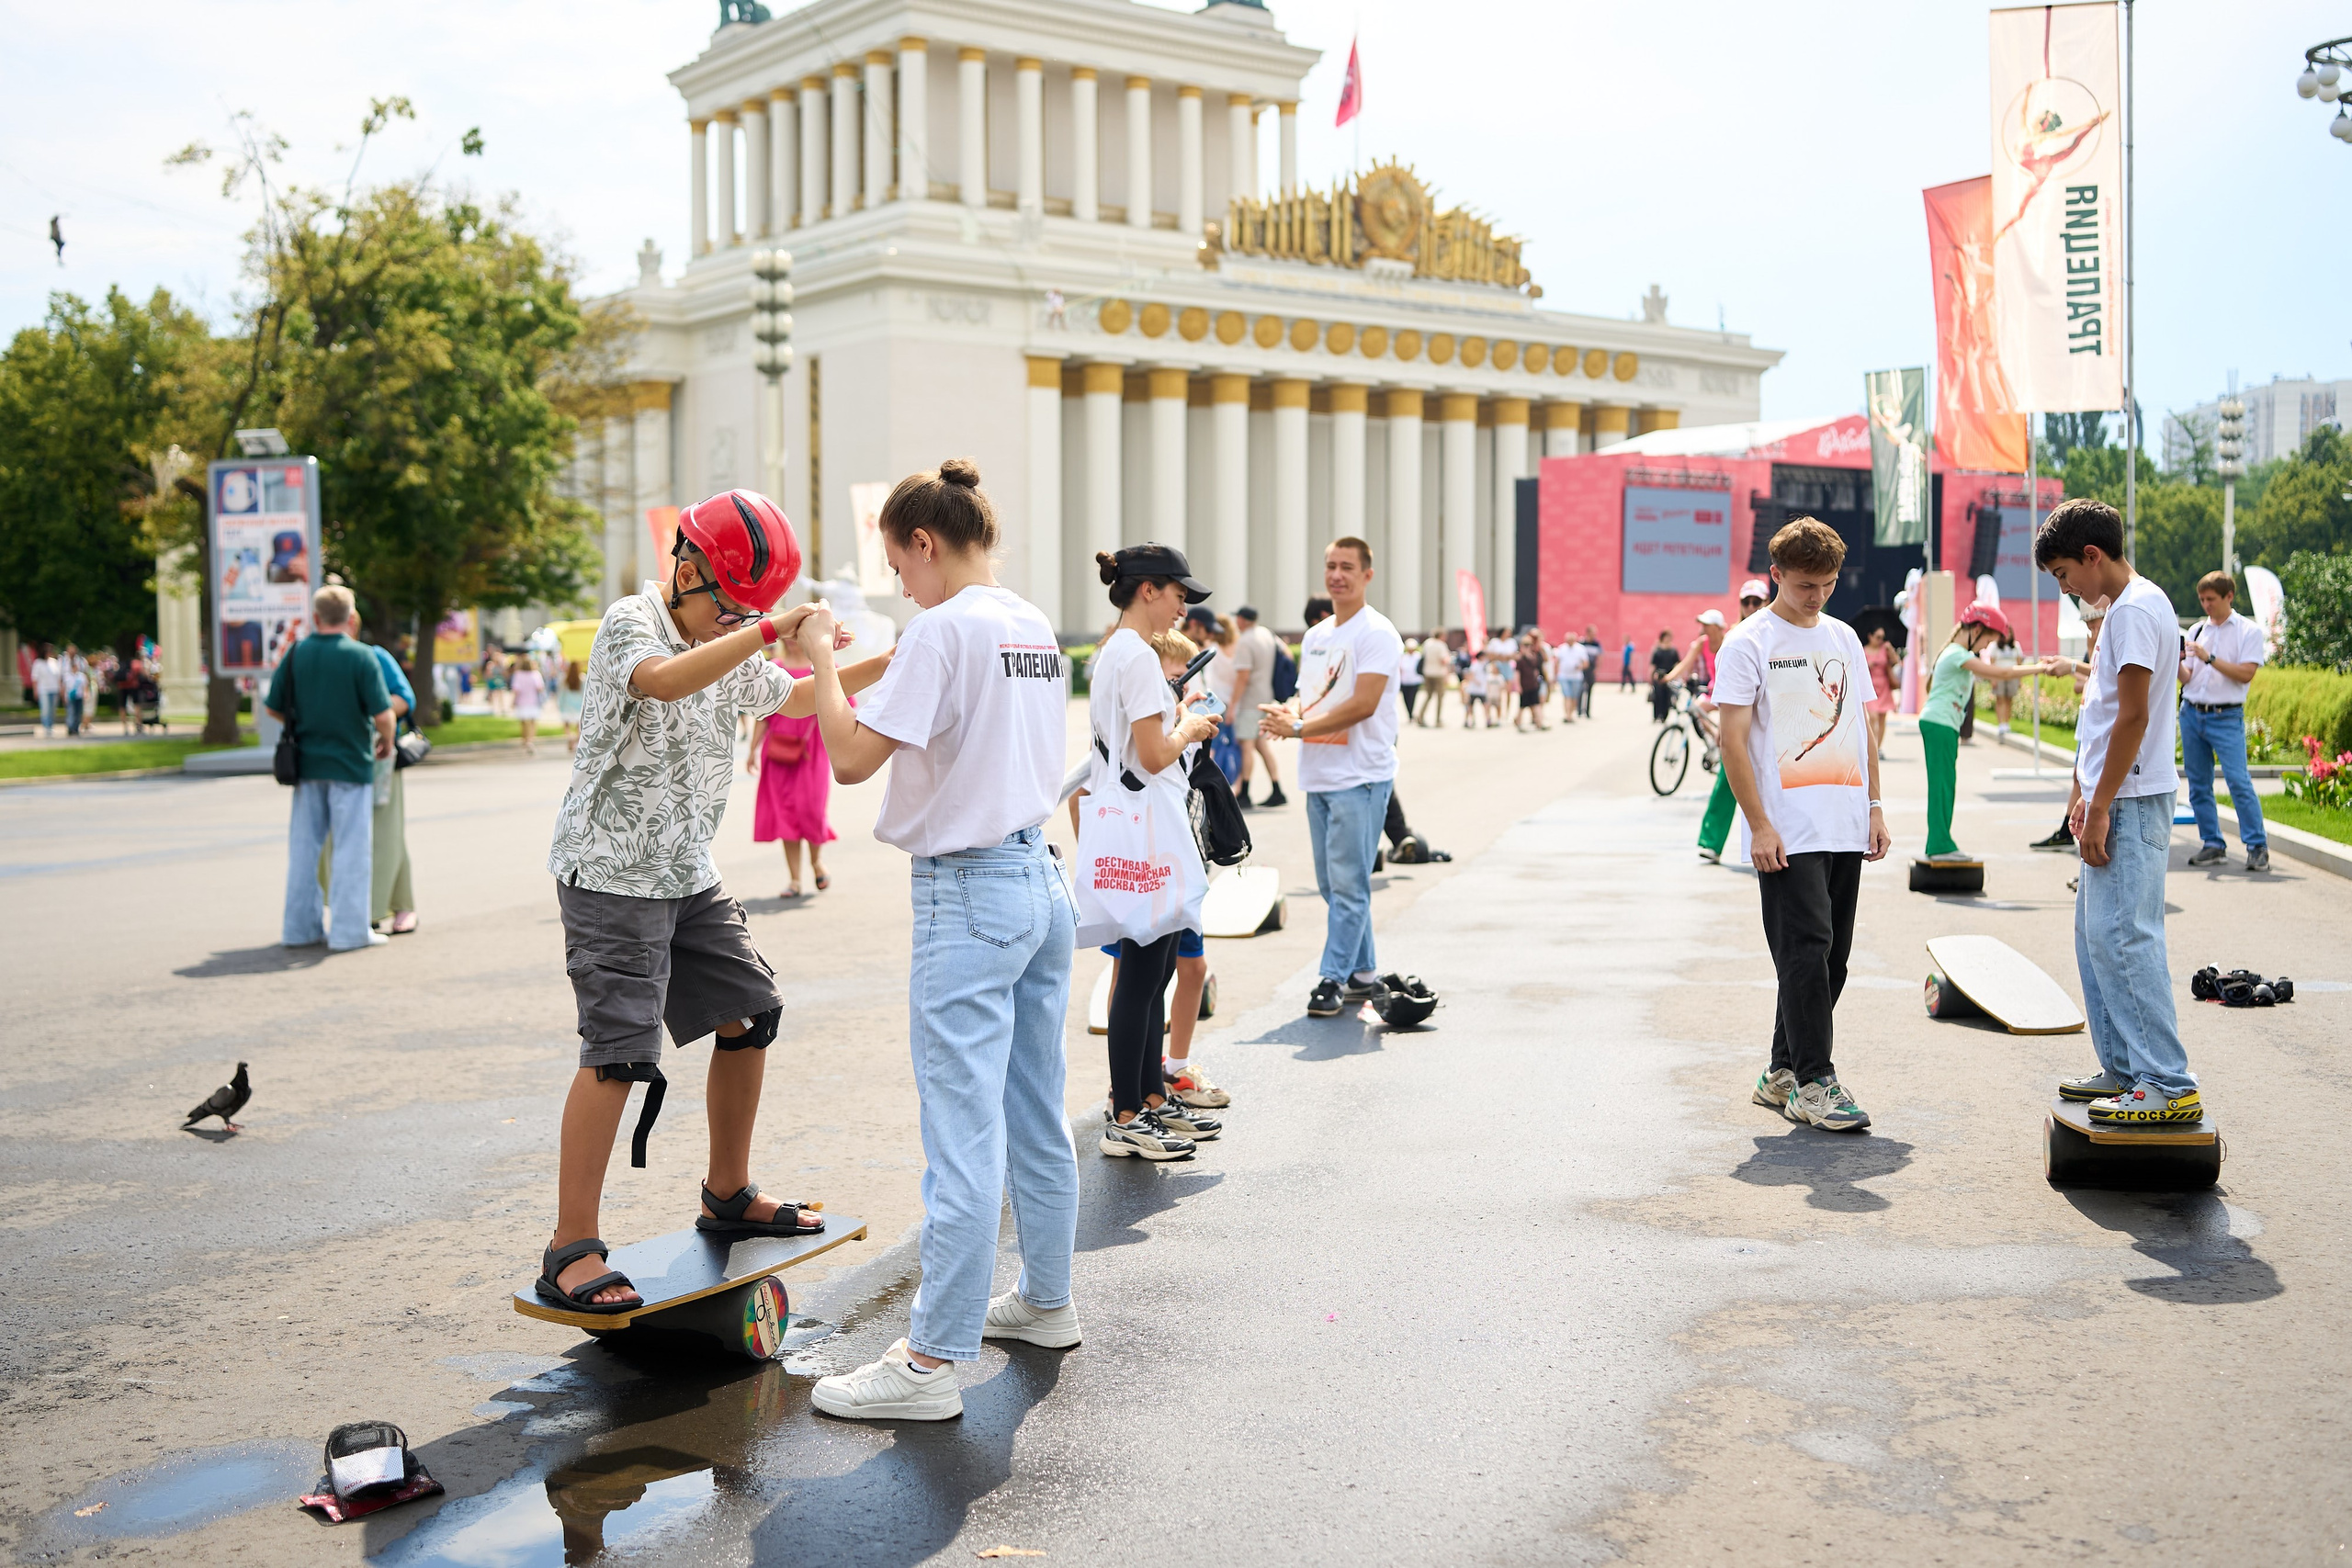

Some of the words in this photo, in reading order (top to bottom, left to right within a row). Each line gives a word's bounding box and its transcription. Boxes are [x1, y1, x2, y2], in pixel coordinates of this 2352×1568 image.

[1769, 659, 1807, 670] ТРАПЕЦИЯ
[1095, 856, 1150, 872] ФЕСТИВАЛЬ
[1094, 865, 1171, 882] «ОЛИМПИЙСКАЯ
[1094, 878, 1135, 892] МОСКВА
[1138, 879, 1165, 893] 2025»
[2115, 1110, 2166, 1121] crocs
